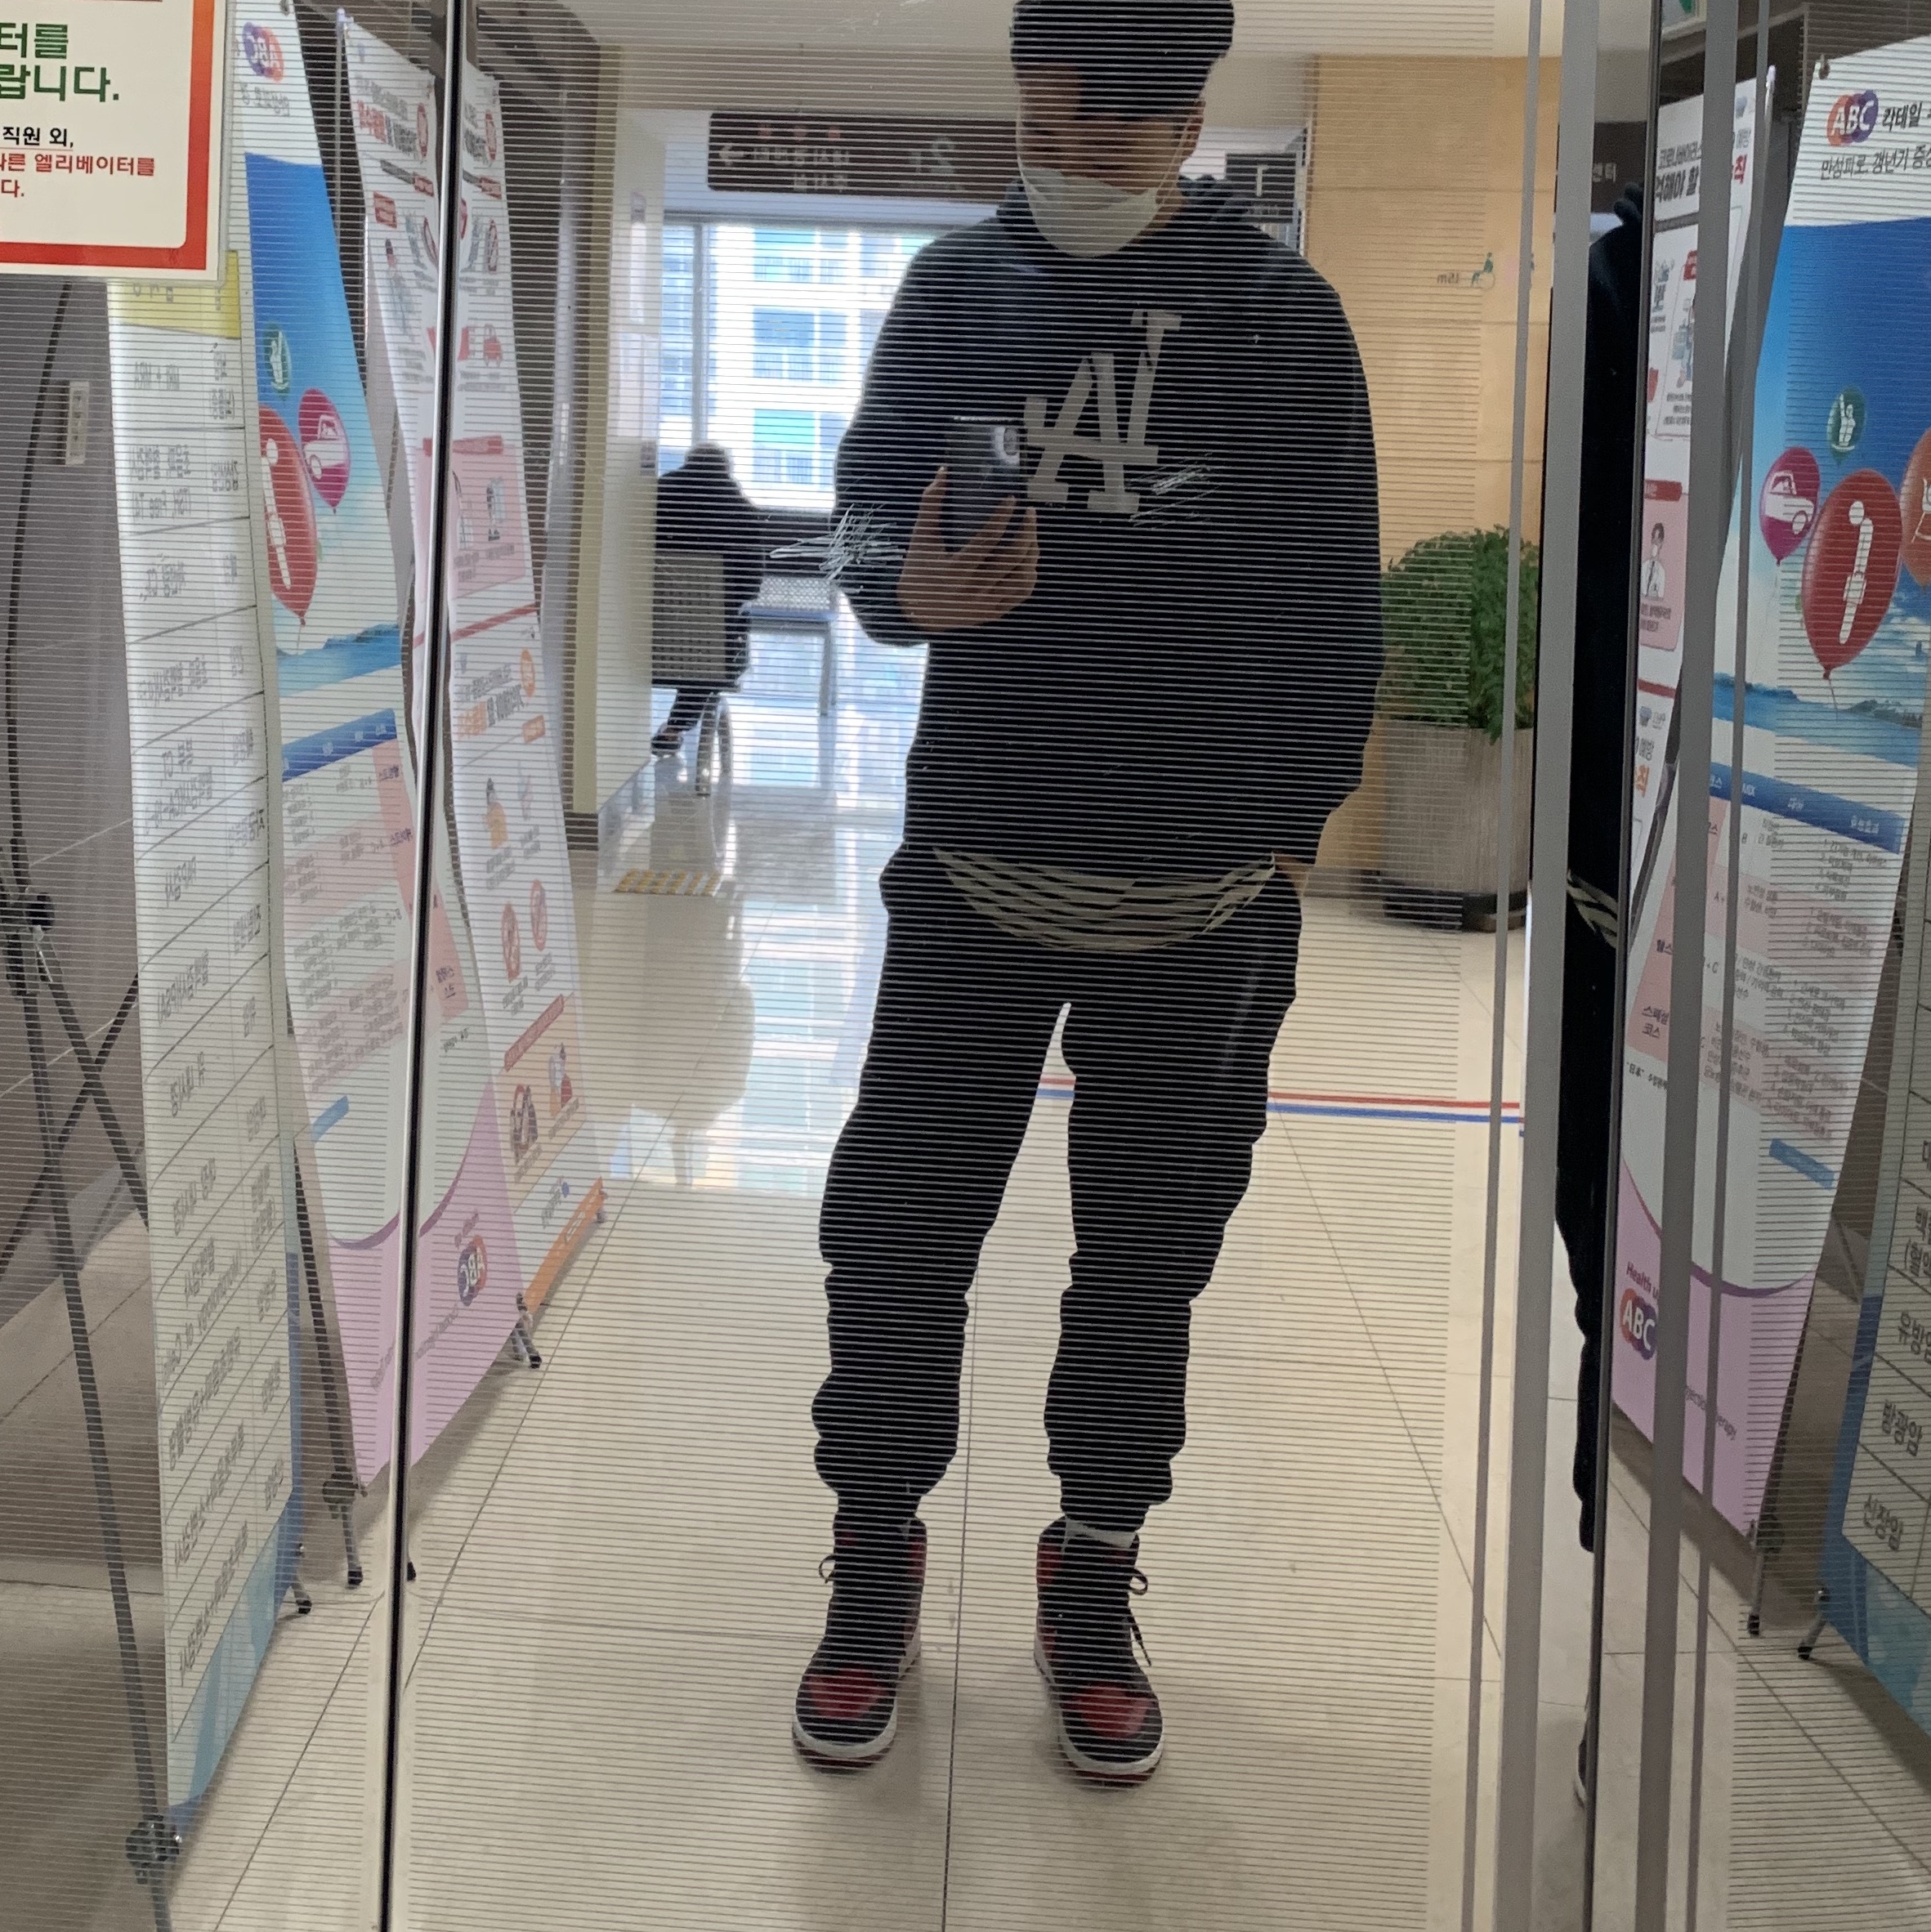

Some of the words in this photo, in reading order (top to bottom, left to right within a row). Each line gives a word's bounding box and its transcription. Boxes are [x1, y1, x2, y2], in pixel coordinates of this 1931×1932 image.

[1830, 100, 1875, 136] ABC
[2, 127, 40, 146] 직원
[49, 127, 74, 148] 외,
[34, 154, 154, 176] 엘리베이터를
[1821, 151, 1869, 181] 만성피로
[1872, 147, 1909, 172] 갱년기
[1642, 1022, 1661, 1039] 코스
[1626, 1261, 1652, 1293] Health
[1622, 1299, 1656, 1350] ABC
[1864, 1494, 1903, 1552] 신장암
